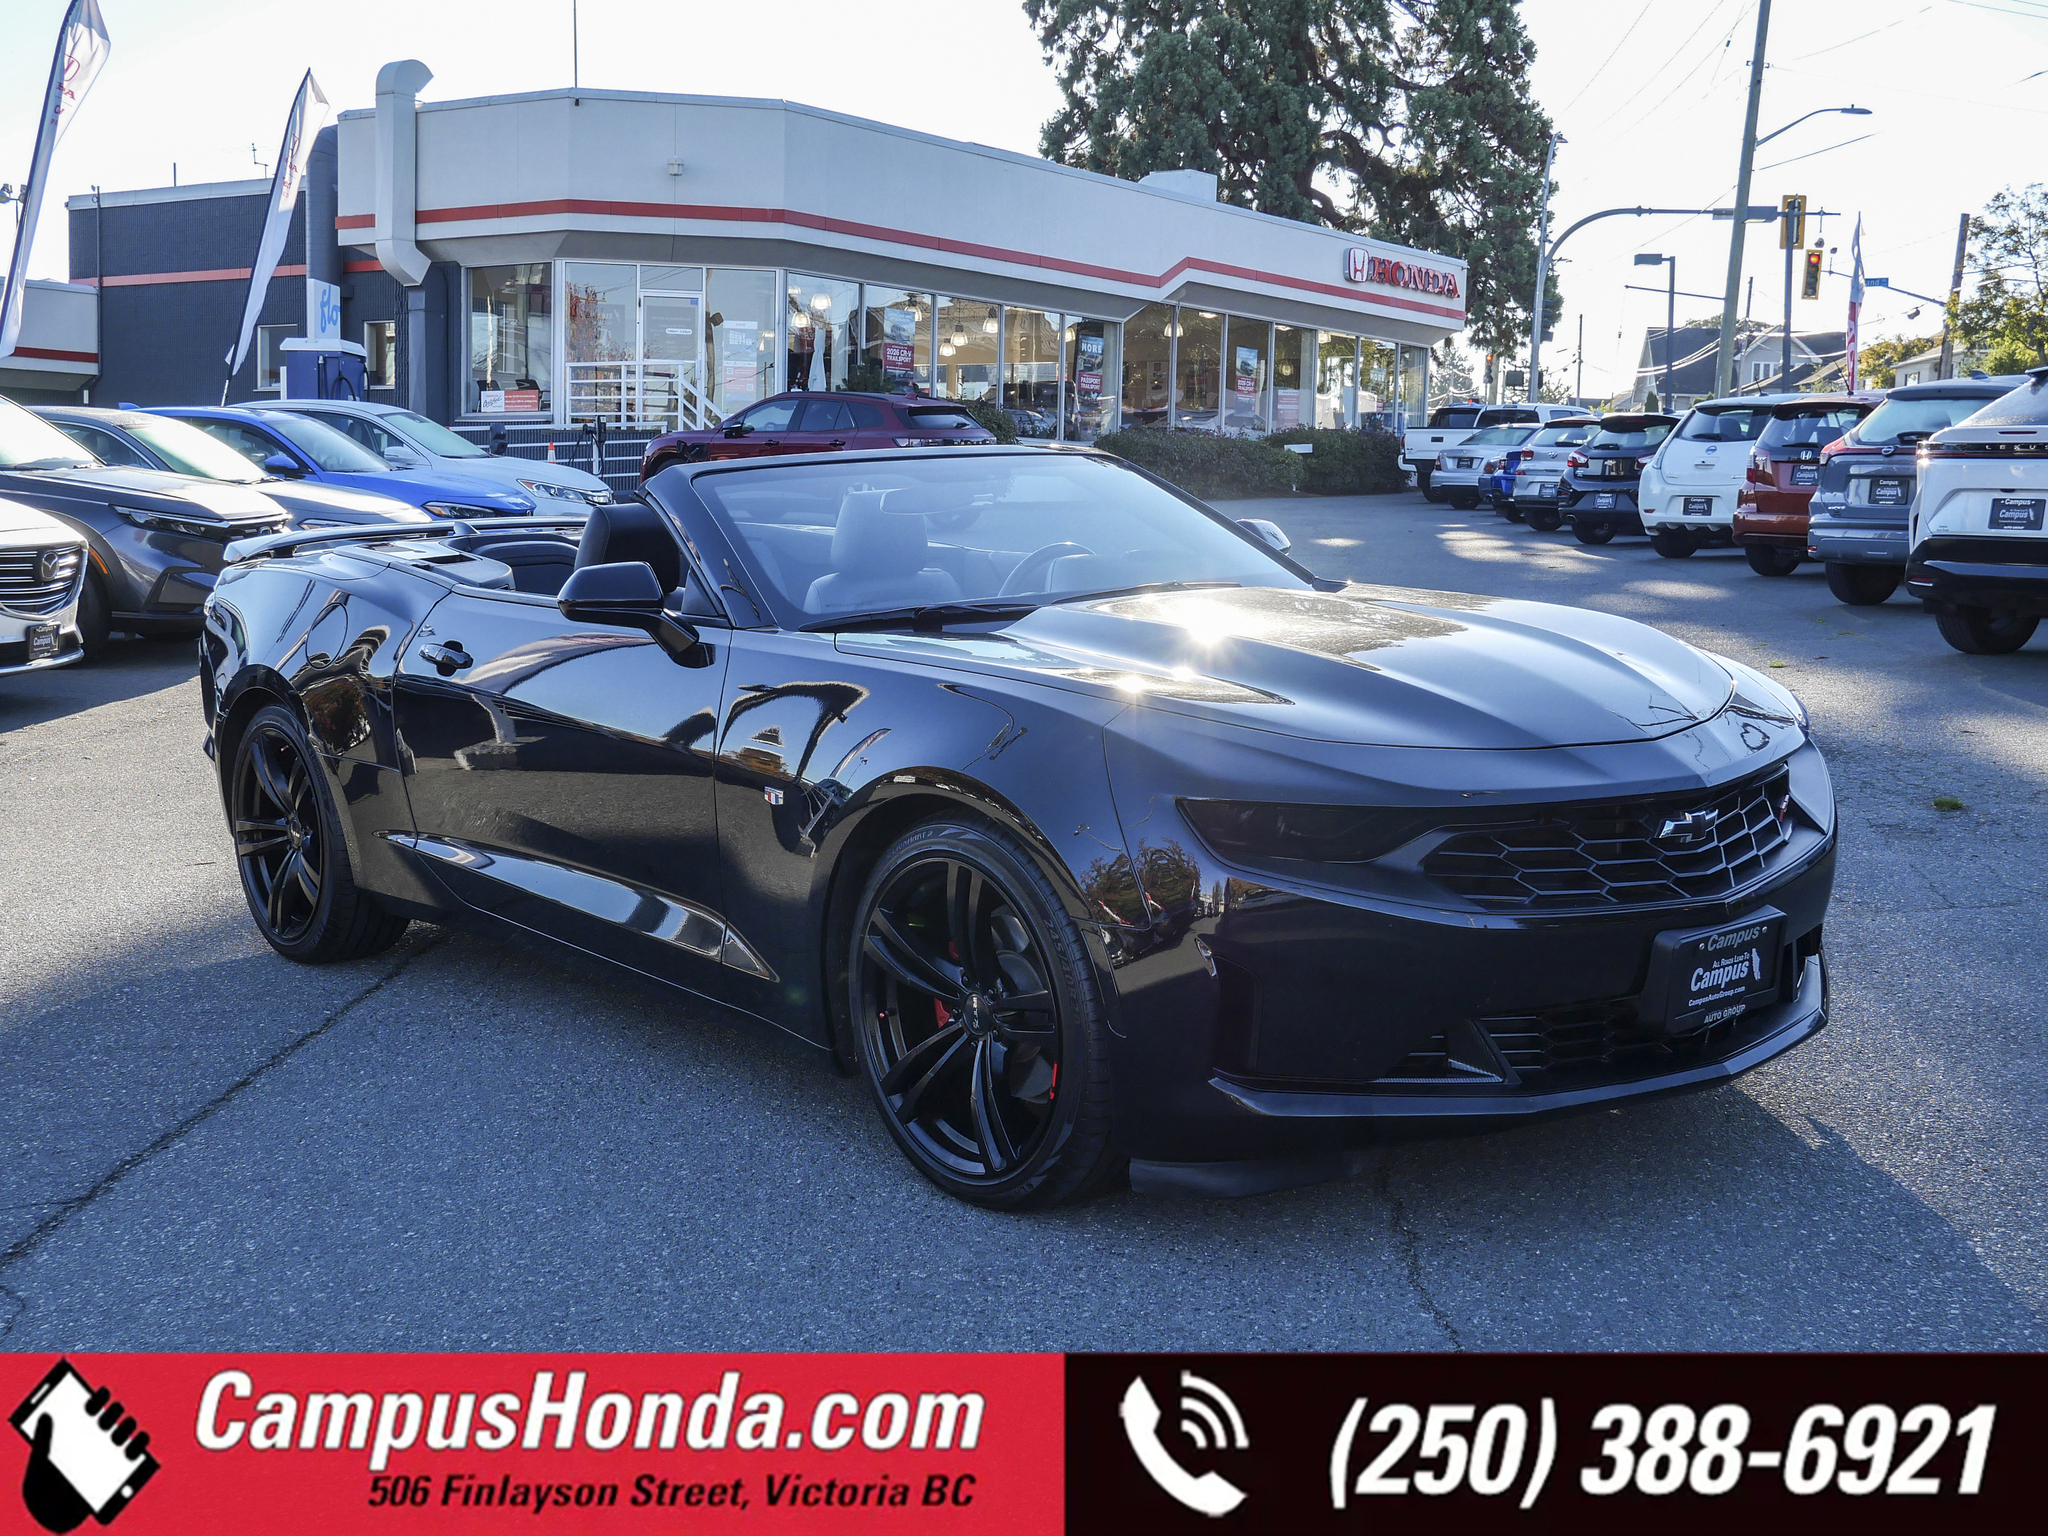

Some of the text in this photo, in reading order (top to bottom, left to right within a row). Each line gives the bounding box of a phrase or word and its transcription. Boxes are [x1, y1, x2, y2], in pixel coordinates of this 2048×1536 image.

[1371, 256, 1461, 298] HONDA
[320, 284, 342, 333] flo
[886, 347, 900, 356] 2026
[900, 349, 912, 357] CR-V
[1081, 342, 1103, 354] MORE
[1876, 488, 1897, 497] Campus
[2004, 498, 2031, 507] Campus
[1999, 509, 2028, 520] Campus
[1707, 926, 1760, 951] Campus
[1690, 960, 1750, 992] Campus
[1688, 985, 1746, 1007] CampusAutoGroup.com
[1703, 1003, 1746, 1024] AUTO GROUP
